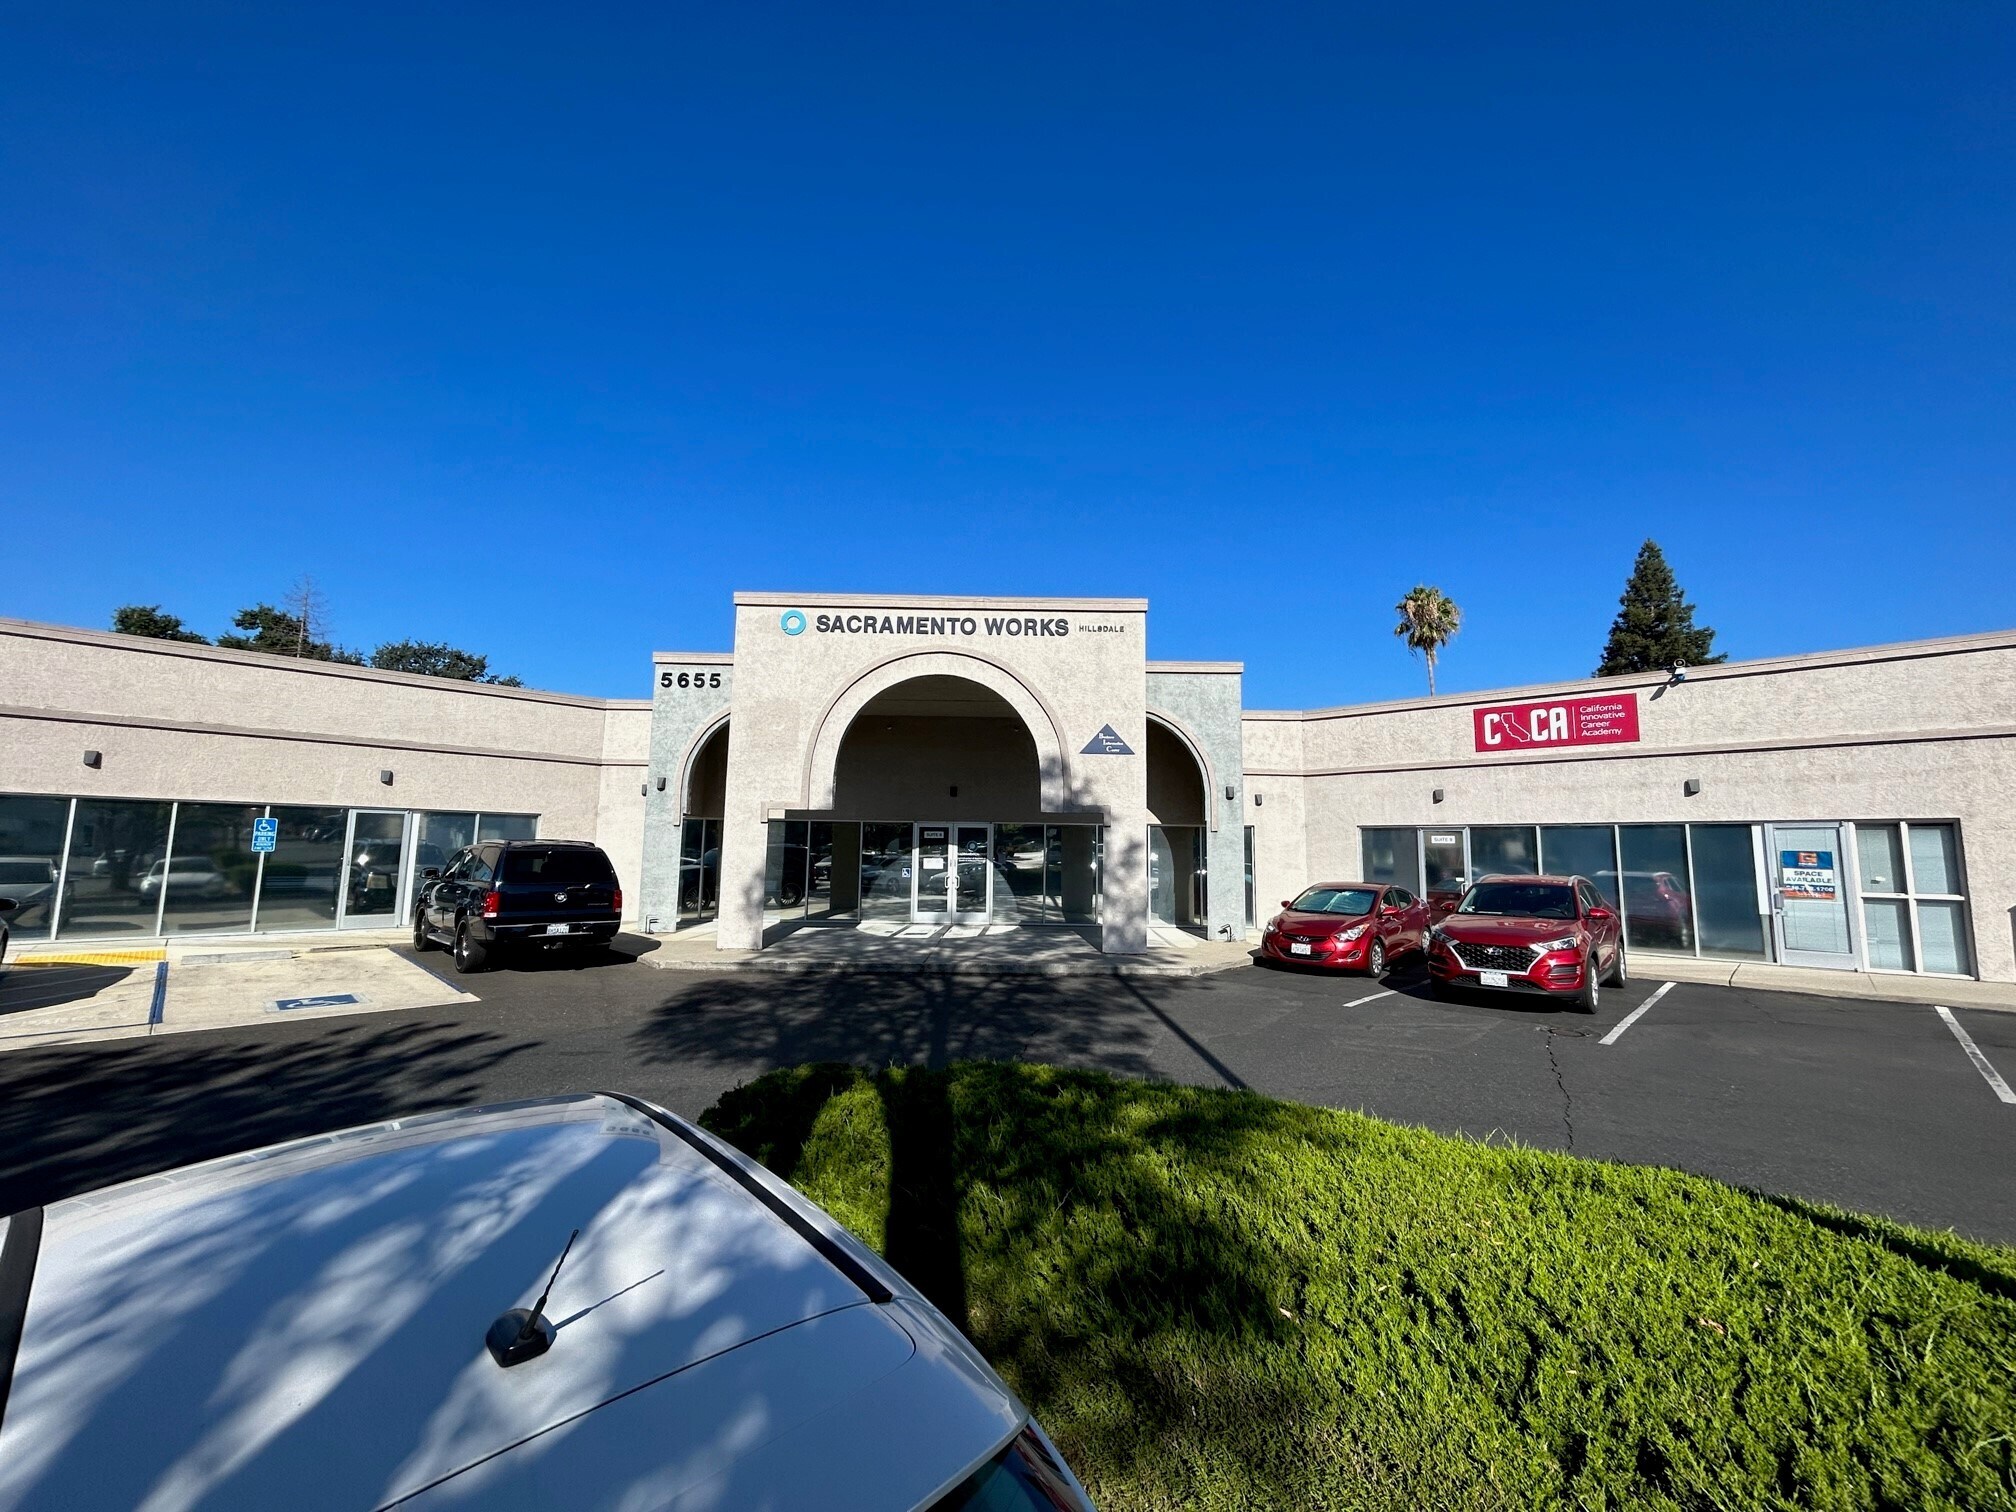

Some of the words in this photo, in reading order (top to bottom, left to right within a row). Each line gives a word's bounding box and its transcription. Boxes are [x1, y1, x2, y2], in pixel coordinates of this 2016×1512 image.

[816, 614, 977, 636] SACRAMENTO
[984, 618, 1069, 636] WORKS
[1078, 625, 1125, 633] HILLSDALE
[660, 672, 721, 689] 5655
[1579, 703, 1623, 713] California
[1580, 711, 1626, 721] Innovative
[1580, 721, 1610, 729] Career
[1581, 728, 1623, 737] Academy
[1785, 876, 1833, 884] AVAILABLE
